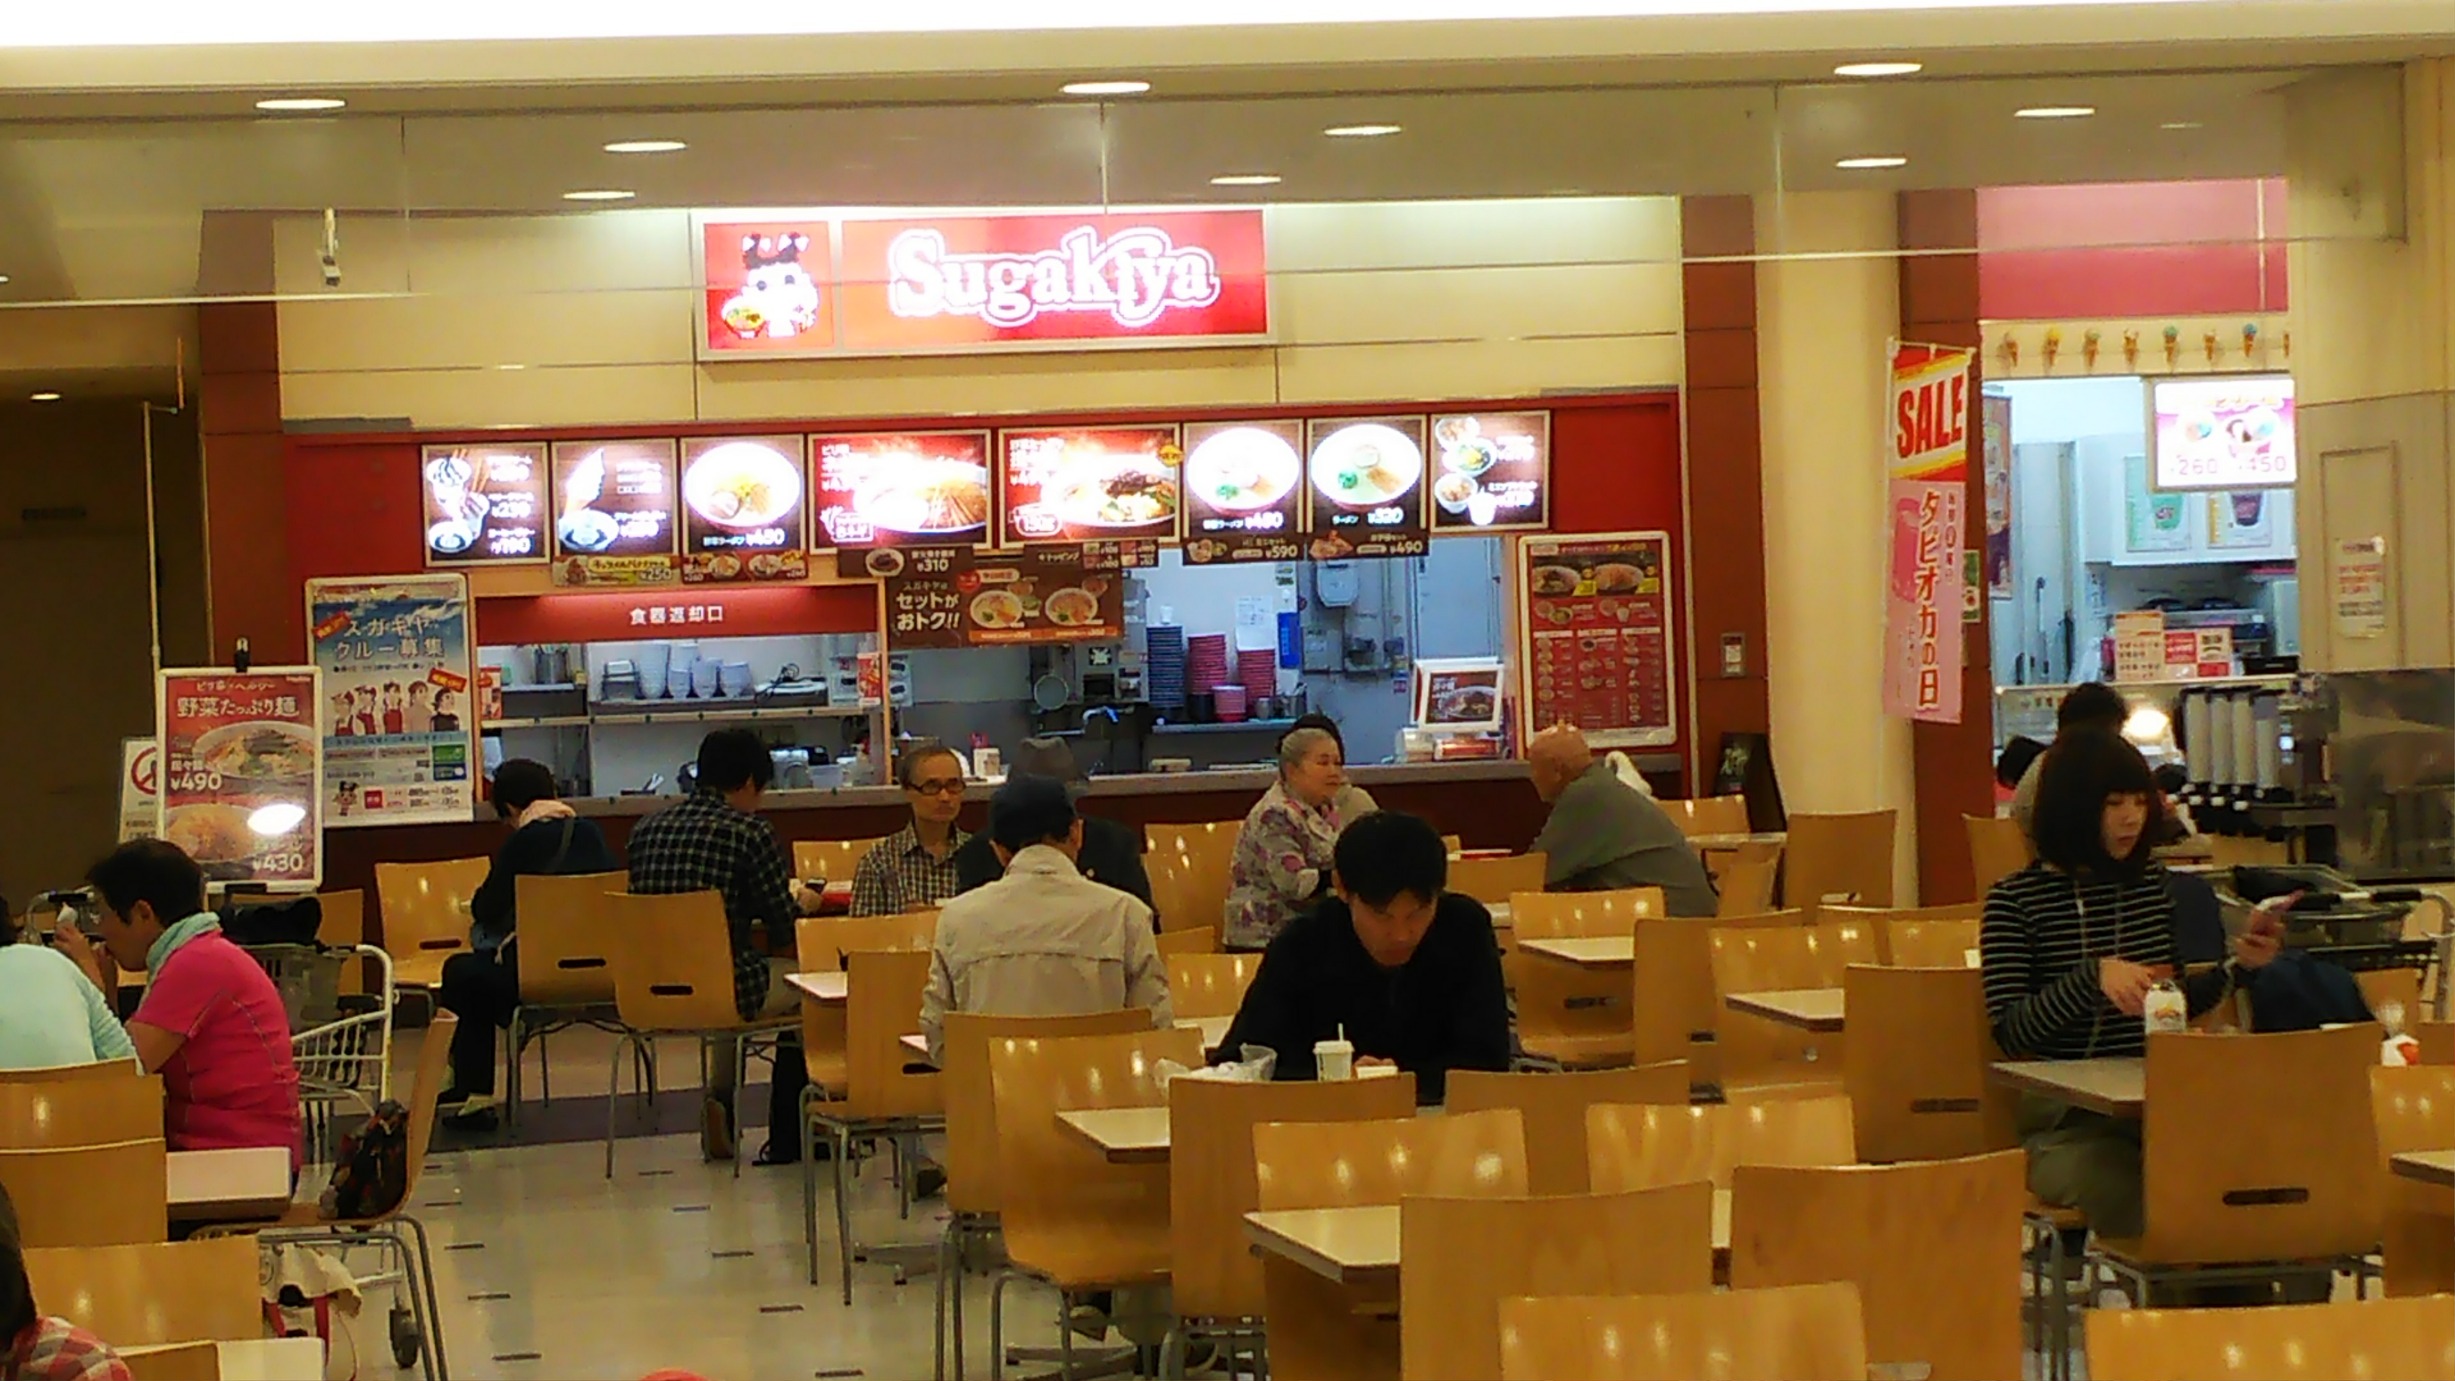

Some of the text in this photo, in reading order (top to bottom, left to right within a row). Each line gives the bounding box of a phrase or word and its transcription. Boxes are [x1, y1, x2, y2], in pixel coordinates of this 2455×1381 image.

[889, 226, 1220, 328] Sugakiya
[1898, 373, 1964, 459] SALE
[1265, 545, 1298, 559] ¥590
[1390, 541, 1423, 553] ¥490
[917, 559, 949, 573] ¥310
[896, 592, 960, 610] セットが
[630, 605, 724, 626] 食器返却口
[897, 612, 961, 632] おトク!!
[343, 614, 432, 638] スガキヤ
[335, 636, 445, 660] クルー募集
[176, 696, 300, 718] 野菜たっぷり麺
[170, 772, 222, 791] ¥490
[252, 853, 304, 872] ¥430
